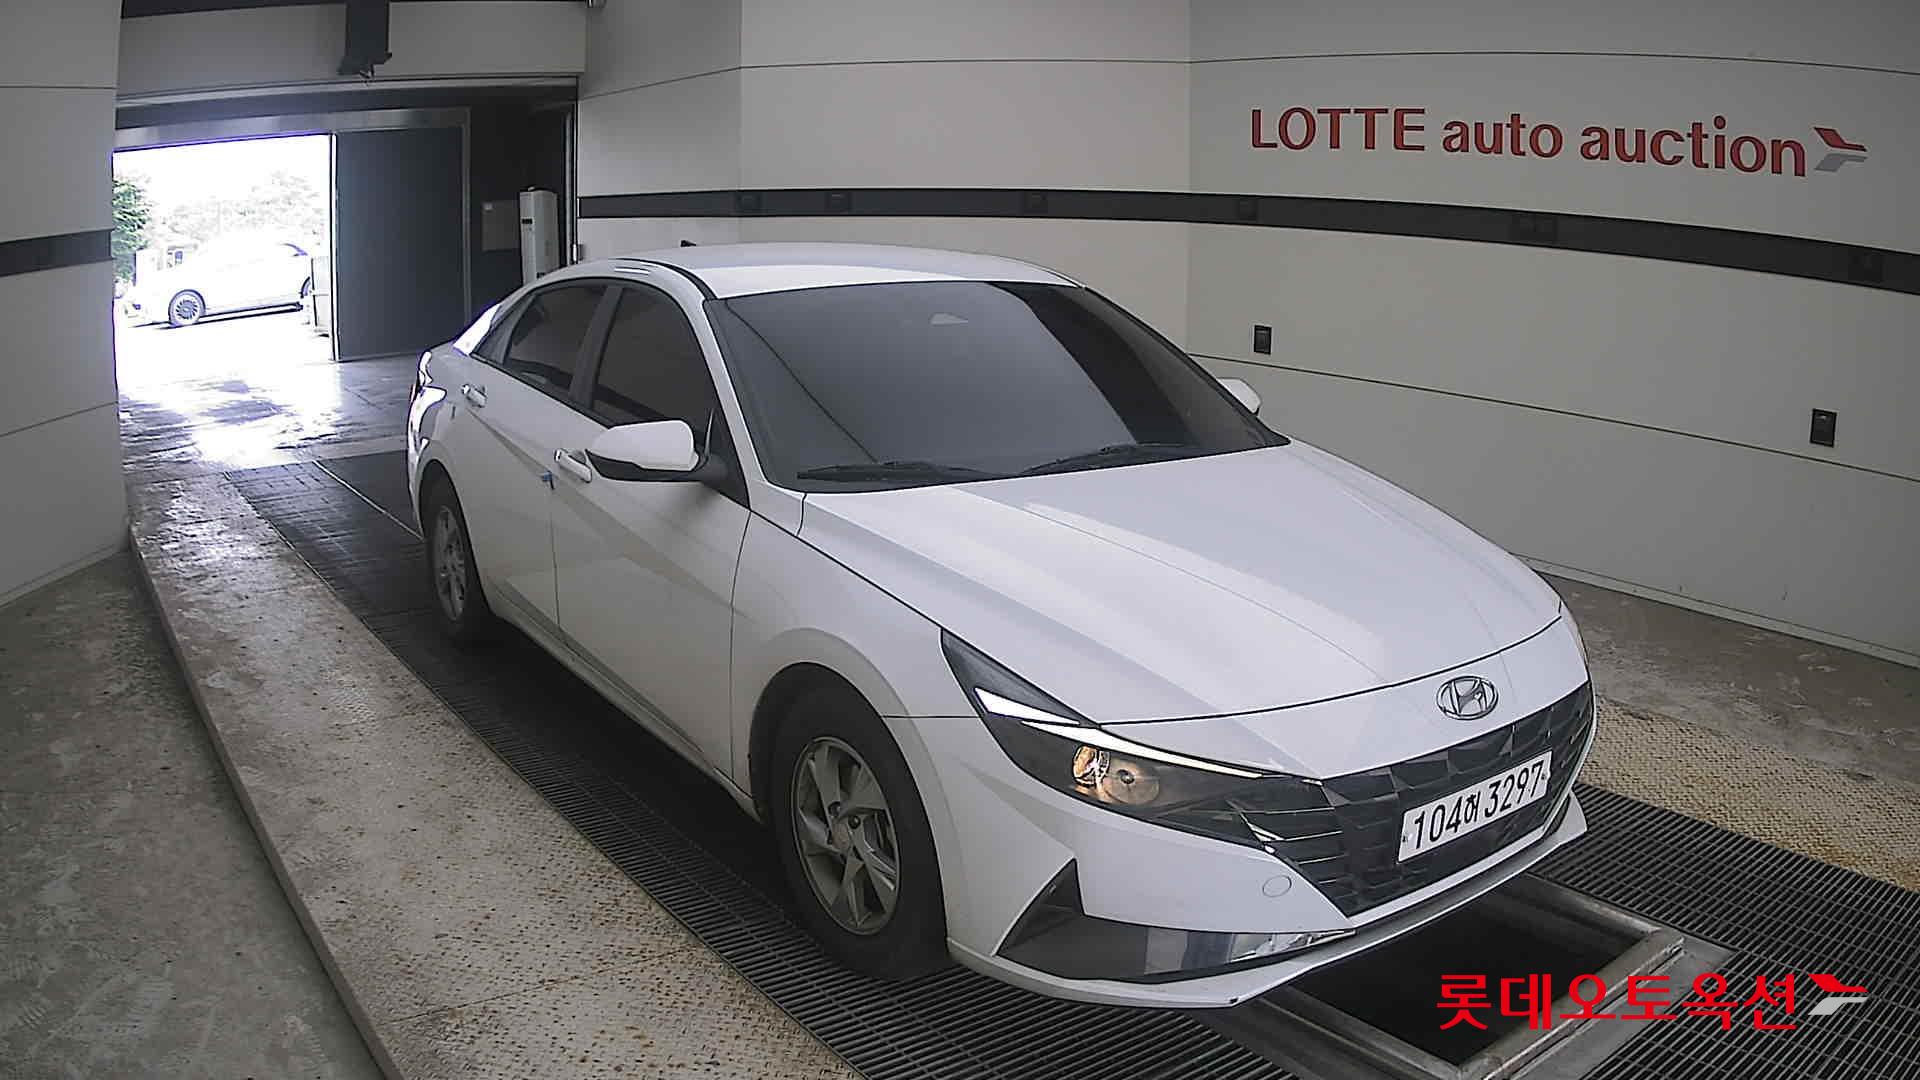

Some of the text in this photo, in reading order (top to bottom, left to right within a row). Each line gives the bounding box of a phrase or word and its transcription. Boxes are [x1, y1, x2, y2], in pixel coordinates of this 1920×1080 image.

[1251, 107, 1806, 177] LOTTE auto auction
